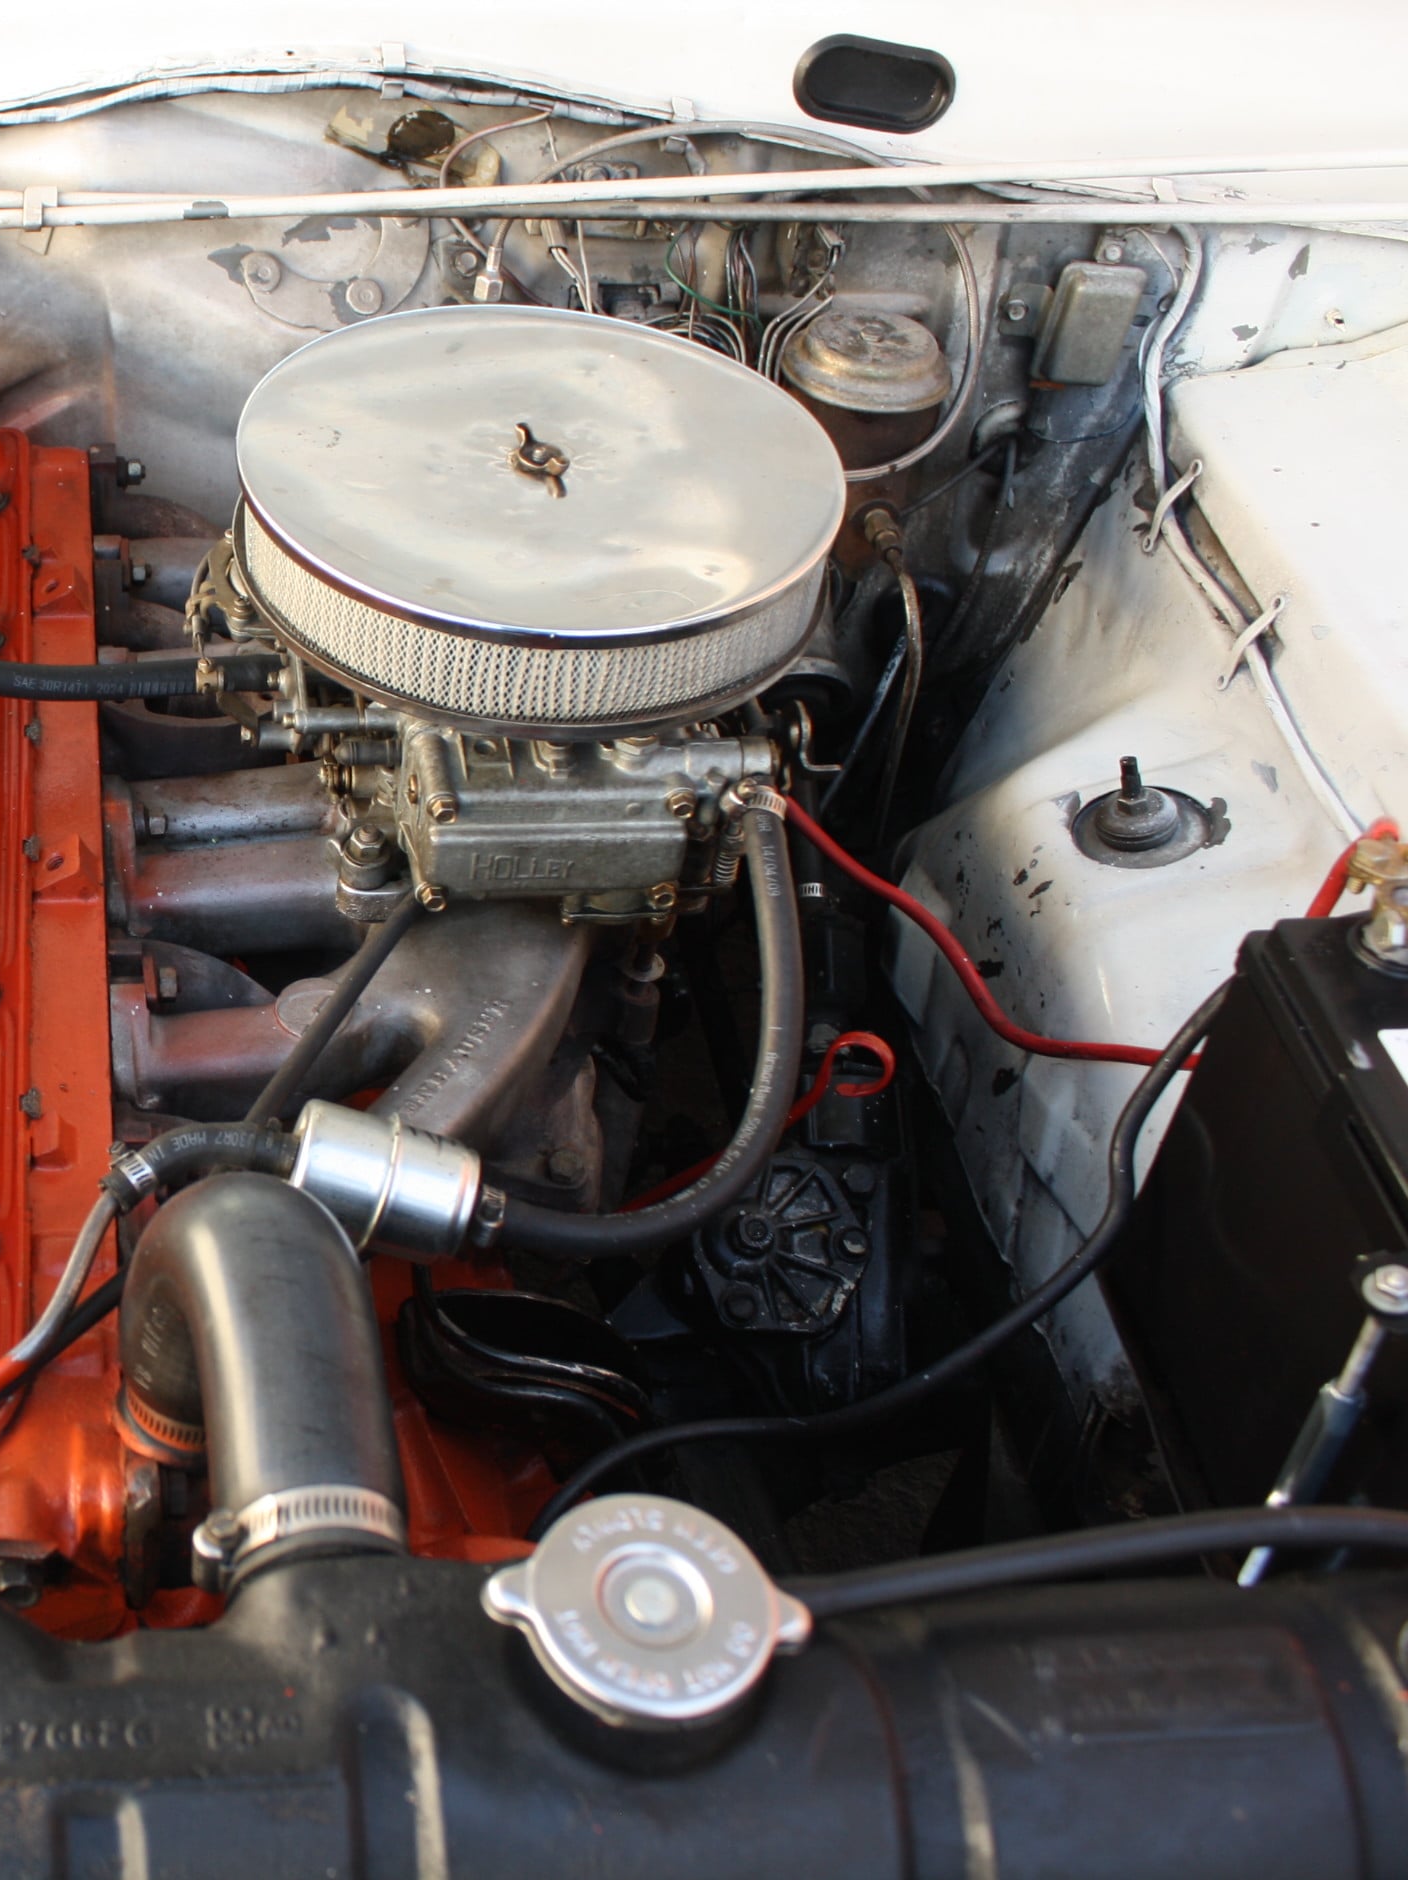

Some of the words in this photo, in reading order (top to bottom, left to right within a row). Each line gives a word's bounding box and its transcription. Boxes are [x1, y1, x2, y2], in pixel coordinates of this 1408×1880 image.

[14, 675, 36, 690] SAE
[469, 852, 576, 881] HOLLEY
[761, 845, 782, 897] 14/04/09
[170, 1130, 207, 1151] MADE
[146, 1143, 165, 1160] IN
